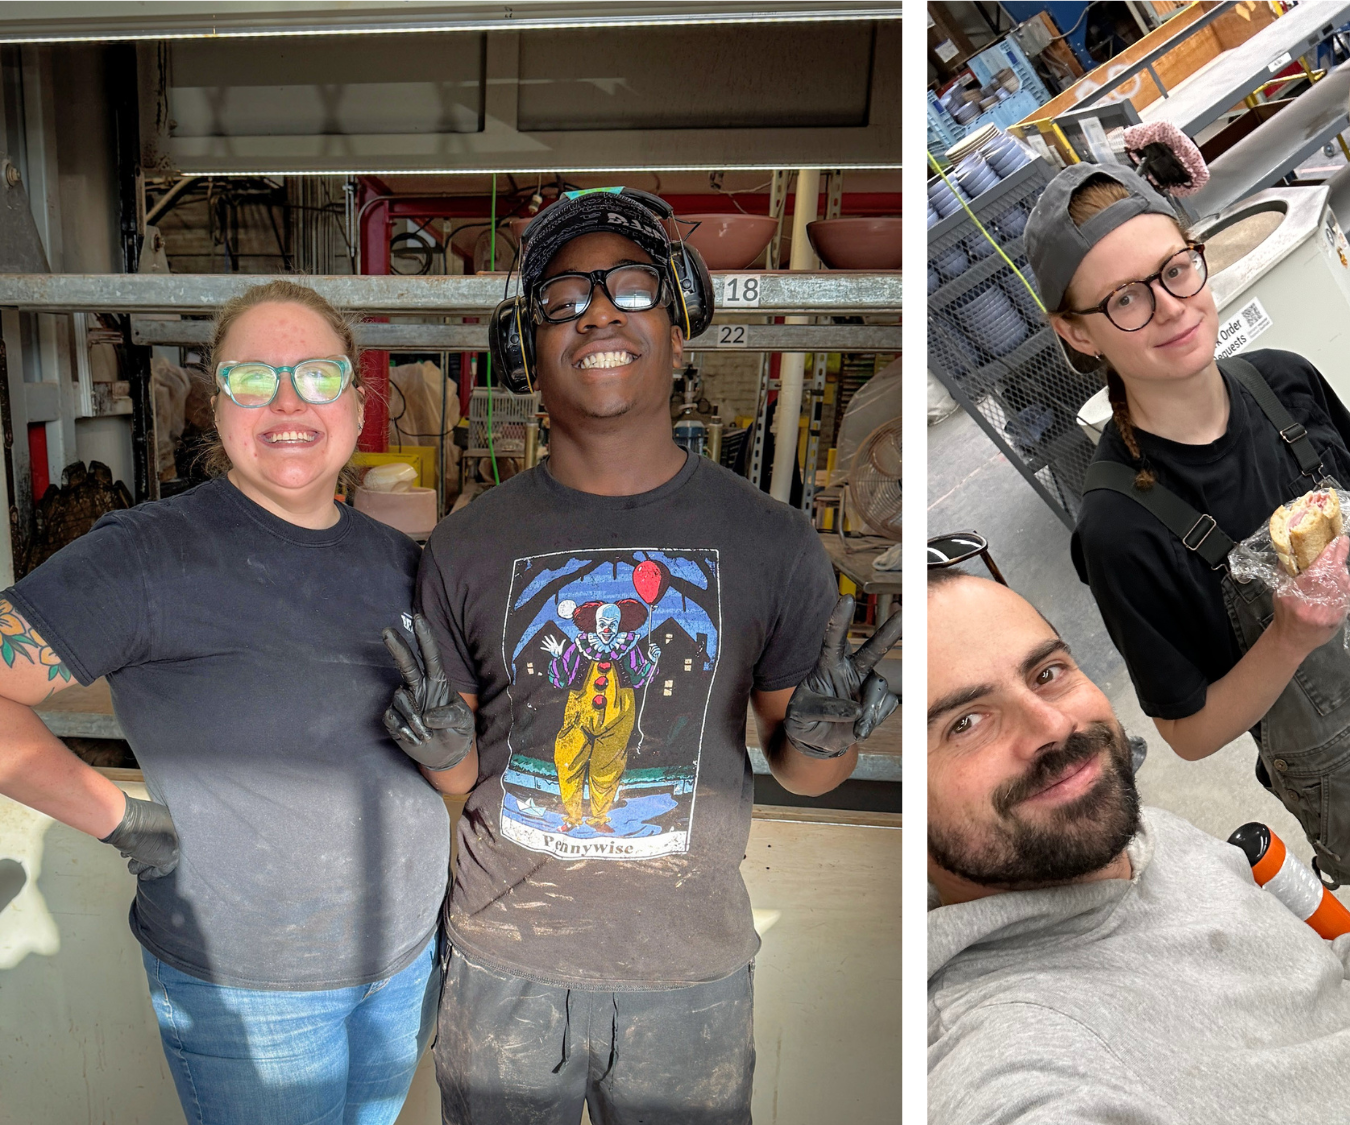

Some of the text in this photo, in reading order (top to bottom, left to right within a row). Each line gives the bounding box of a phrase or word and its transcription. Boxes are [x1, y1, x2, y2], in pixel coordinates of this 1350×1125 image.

[727, 278, 759, 301] 18
[720, 326, 745, 344] 22
[1220, 319, 1242, 341] Order
[1214, 334, 1247, 360] equests
[543, 834, 634, 857] Pennywise
